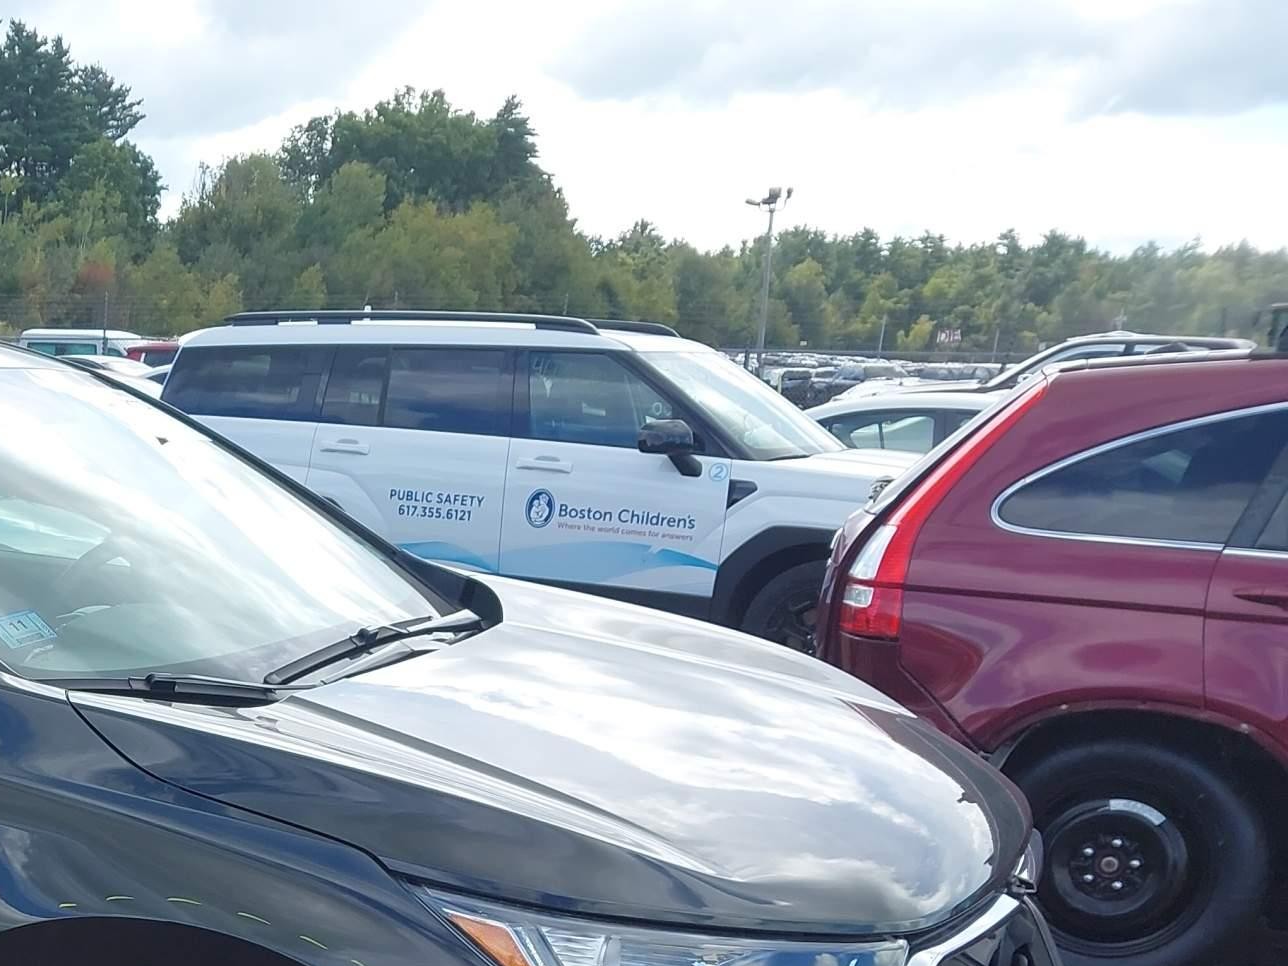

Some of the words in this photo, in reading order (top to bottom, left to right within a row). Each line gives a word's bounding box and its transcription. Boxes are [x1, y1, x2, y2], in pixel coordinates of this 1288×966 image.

[713, 464, 724, 480] 2
[389, 488, 433, 504] PUBLIC
[435, 492, 485, 508] SAFETY
[398, 504, 472, 521] 617.355.6121
[558, 503, 613, 522] Boston
[617, 508, 696, 530] Children's
[557, 521, 581, 531] Where
[583, 523, 598, 533] the
[598, 525, 620, 535] world
[620, 528, 647, 538] comes
[648, 529, 659, 538] for
[660, 532, 694, 541] answers
